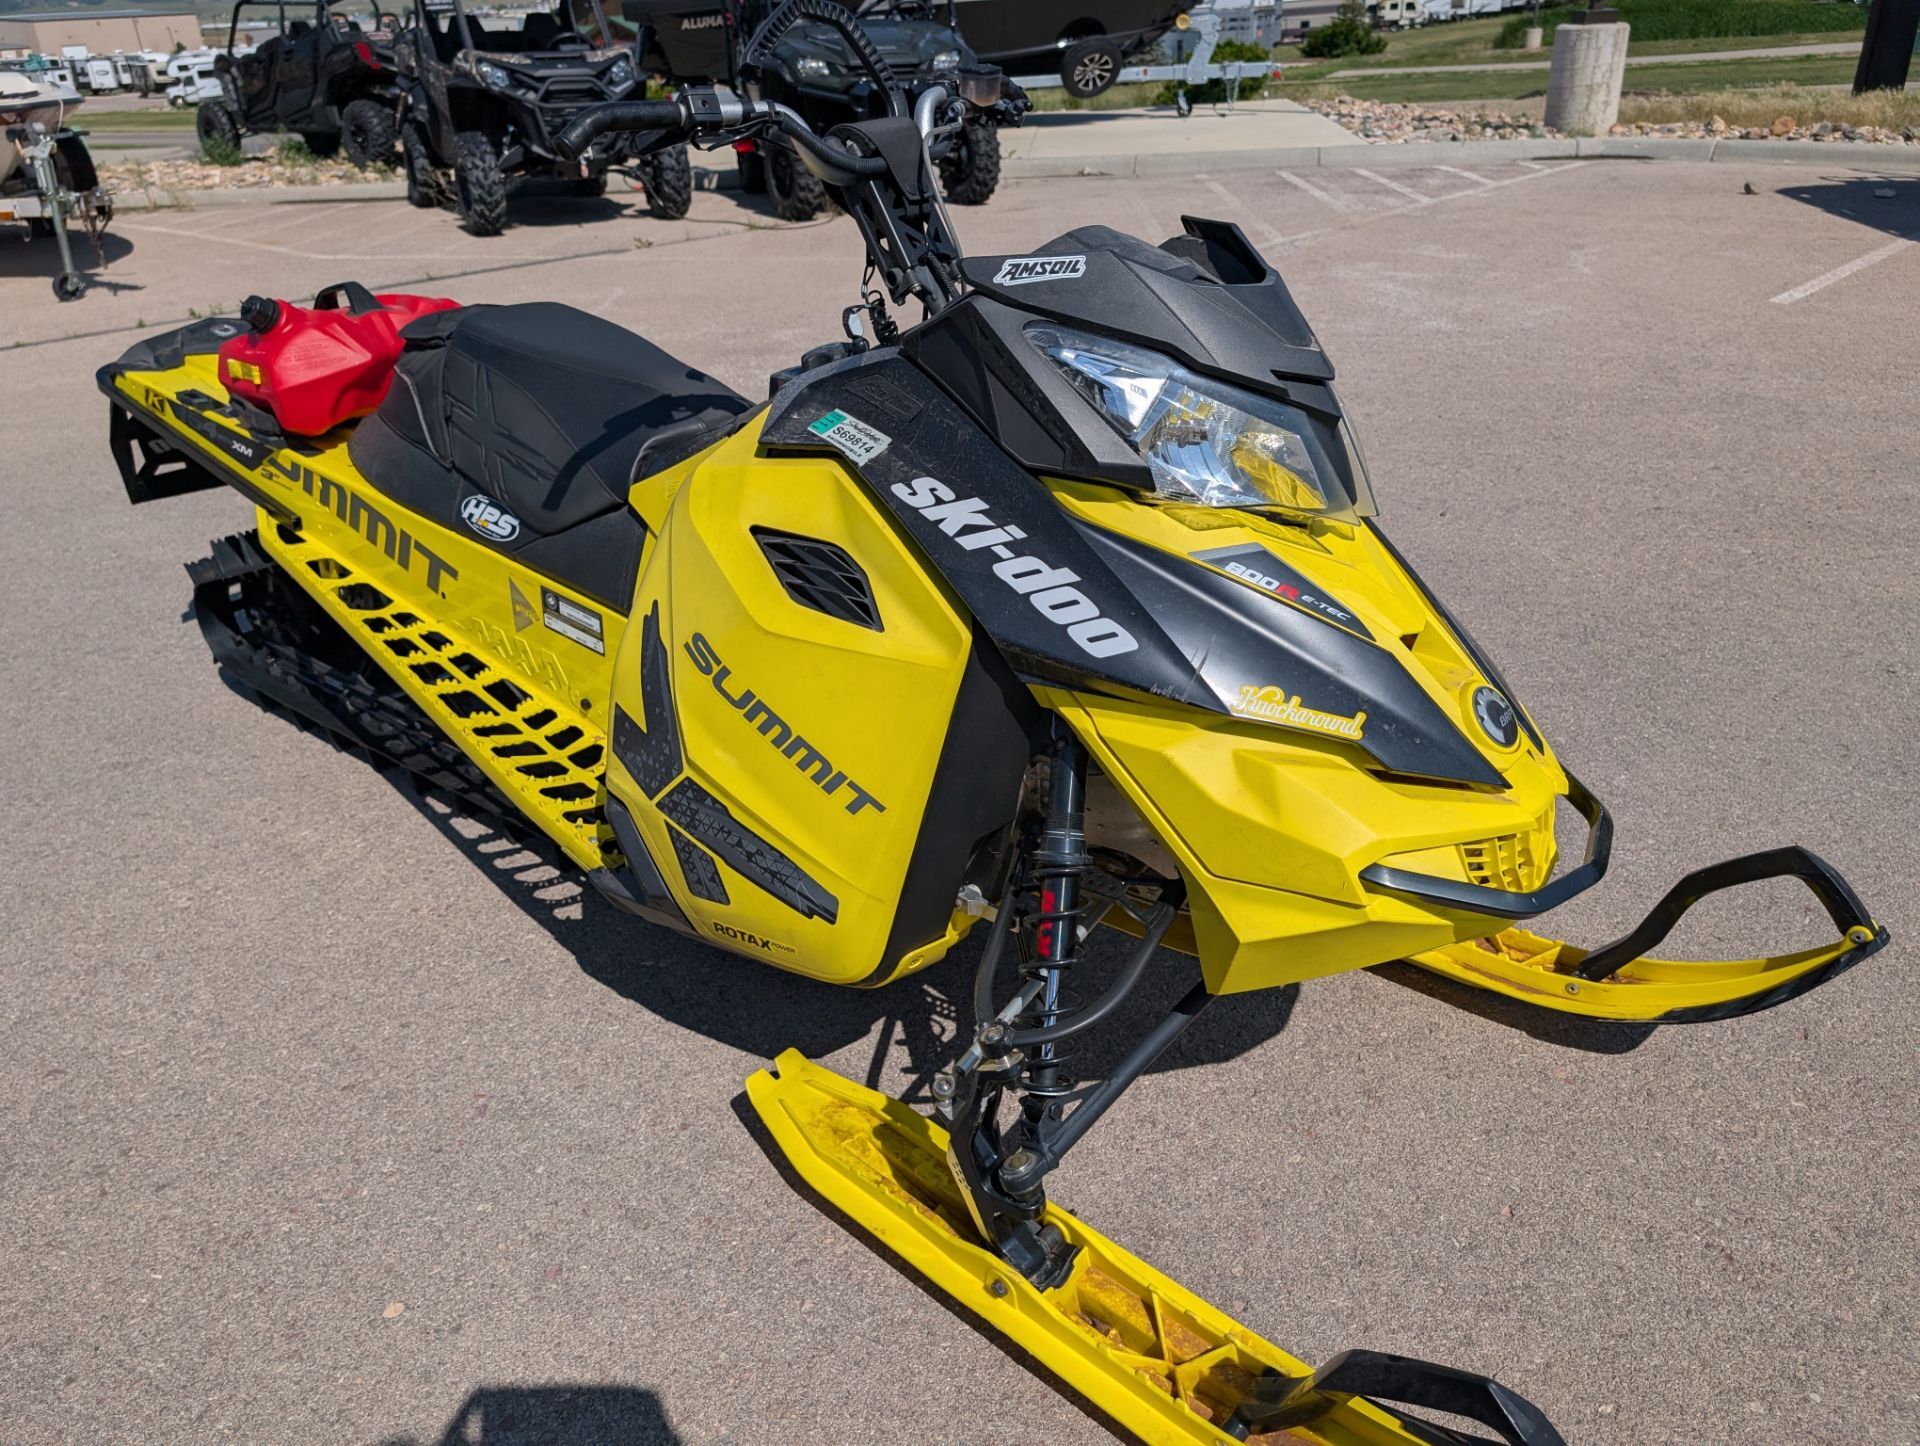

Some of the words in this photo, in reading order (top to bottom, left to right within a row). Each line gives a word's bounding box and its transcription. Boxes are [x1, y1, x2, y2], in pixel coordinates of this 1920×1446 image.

[1001, 259, 1082, 281] AMSOIL
[231, 440, 253, 457] XM
[832, 426, 875, 454] S69814
[890, 476, 1140, 659] ski-doo
[1224, 561, 1300, 602] 800R
[1301, 595, 1351, 620] E-TEC
[683, 632, 887, 816] SUMMIT
[1232, 685, 1363, 737] Knockaround
[713, 922, 772, 951] ROTAX
[771, 941, 796, 954] POWER
